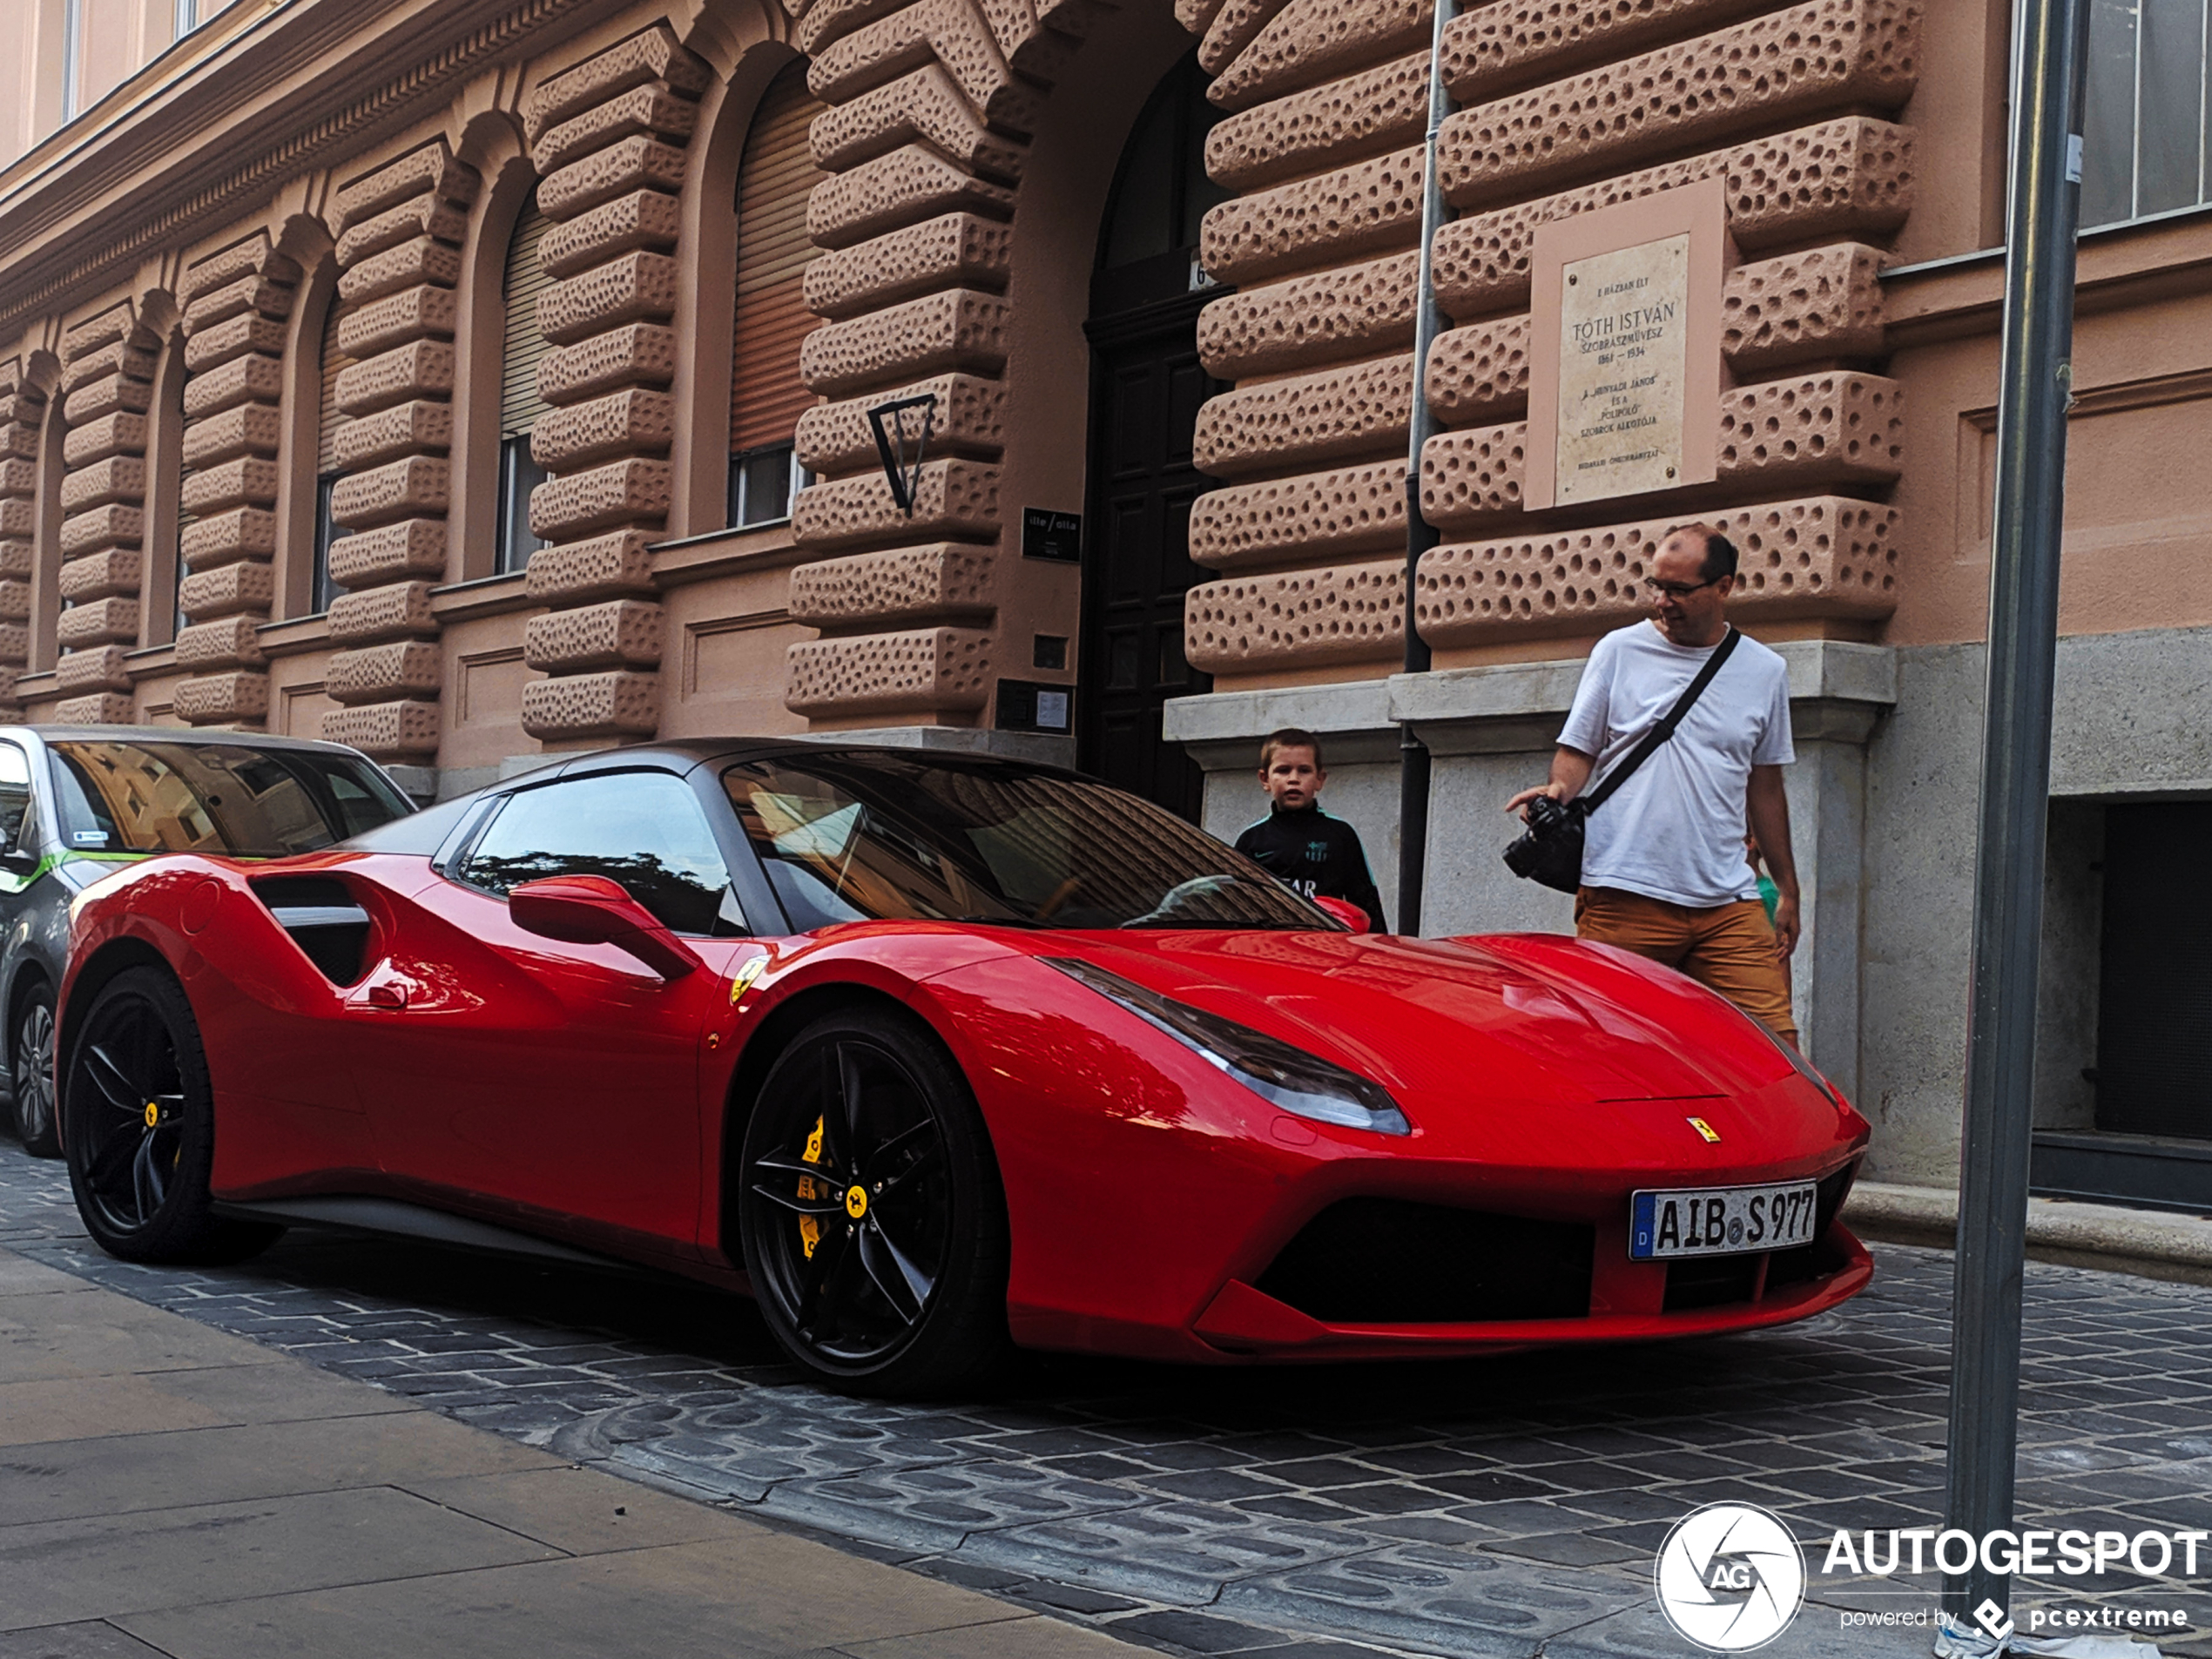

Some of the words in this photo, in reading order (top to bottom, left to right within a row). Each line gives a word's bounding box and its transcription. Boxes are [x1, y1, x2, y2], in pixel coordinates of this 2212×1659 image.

[1197, 265, 1205, 284] 6
[1573, 316, 1613, 341] TÓTH
[1619, 298, 1675, 331] ISTVÁN
[1628, 346, 1645, 359] 1934
[1611, 395, 1621, 407] ÉS
[1622, 395, 1628, 404] A
[1657, 1197, 1726, 1249] AIB
[1638, 1231, 1648, 1246] D
